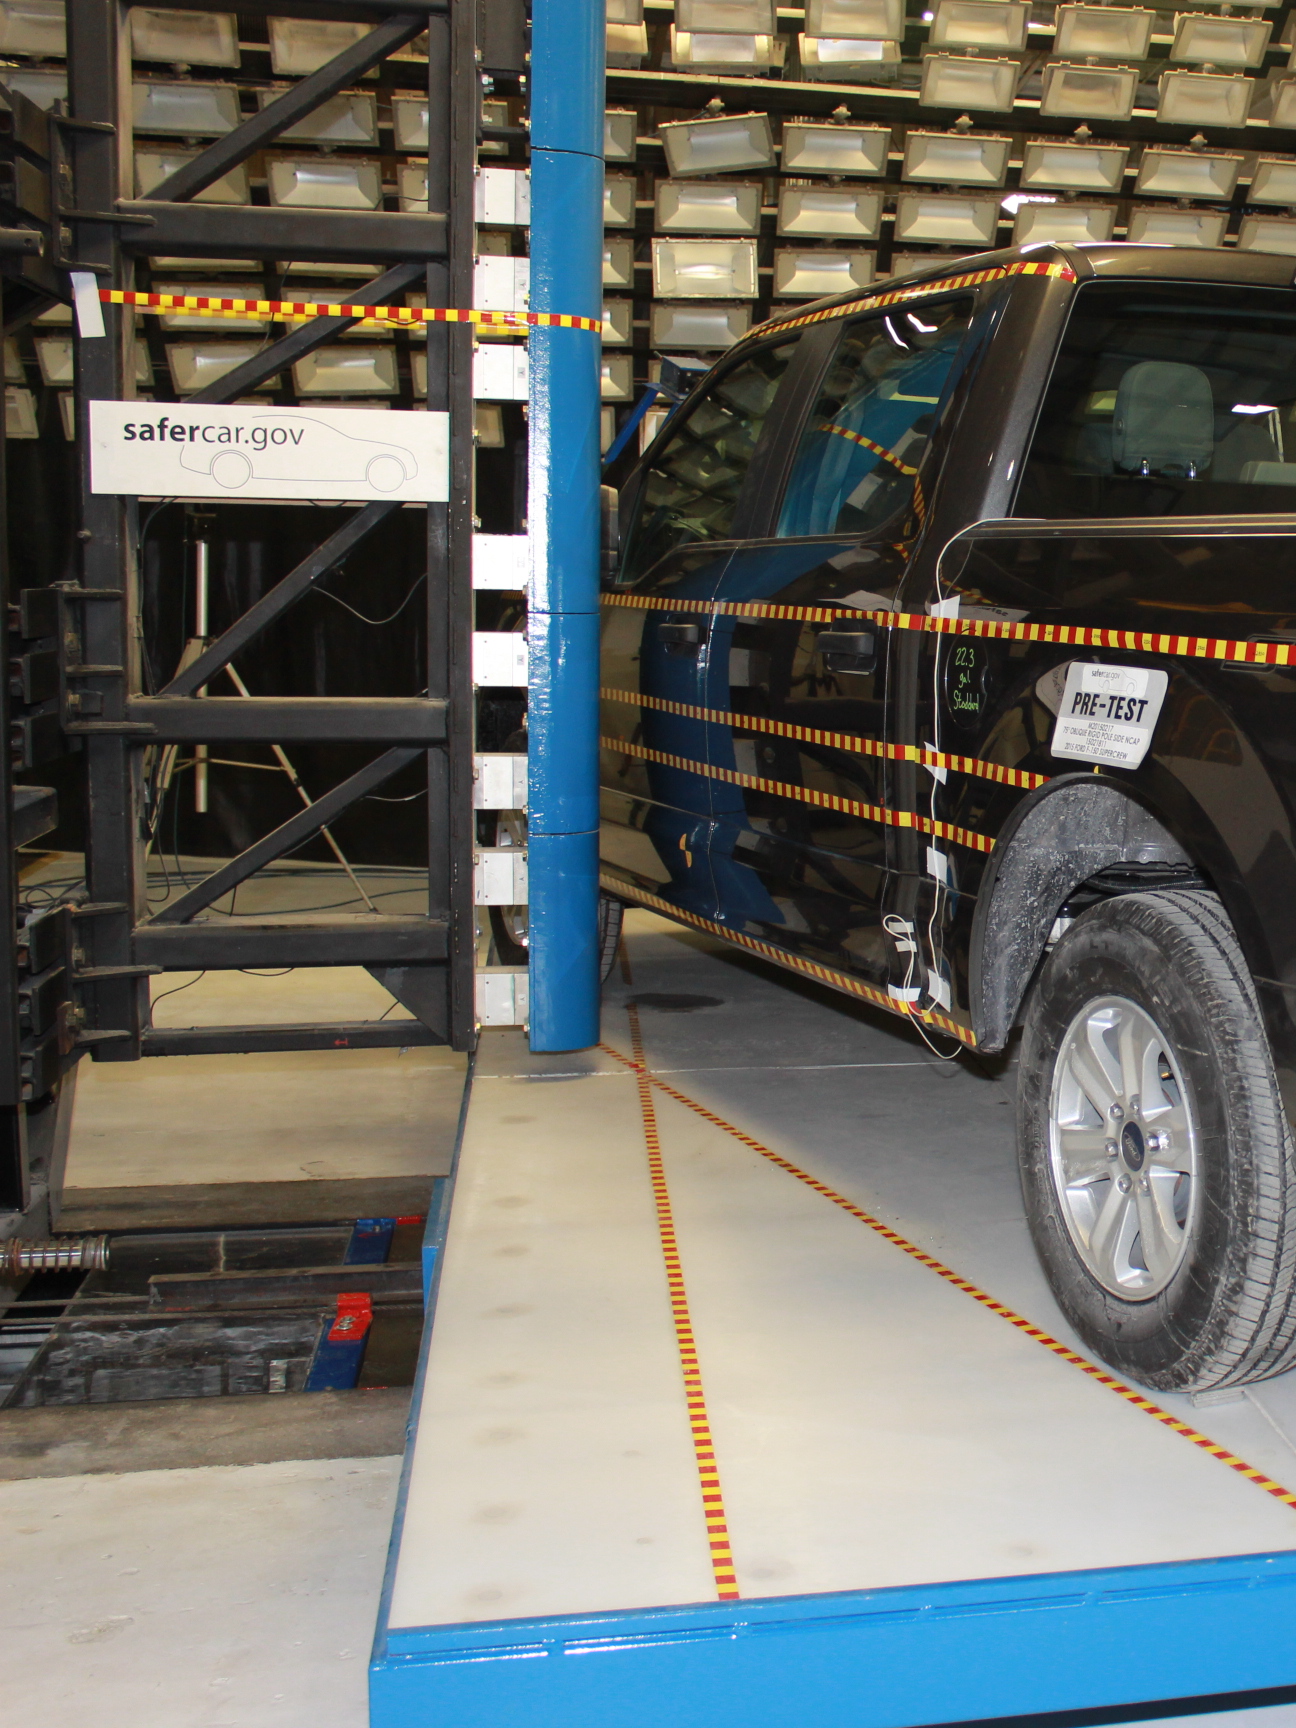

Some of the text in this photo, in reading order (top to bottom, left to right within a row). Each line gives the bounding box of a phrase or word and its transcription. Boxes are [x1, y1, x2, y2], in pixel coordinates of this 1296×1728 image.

[123, 416, 305, 451] safercar.gov
[955, 646, 975, 668] 22.3
[1071, 692, 1149, 723] PRE-TEST
